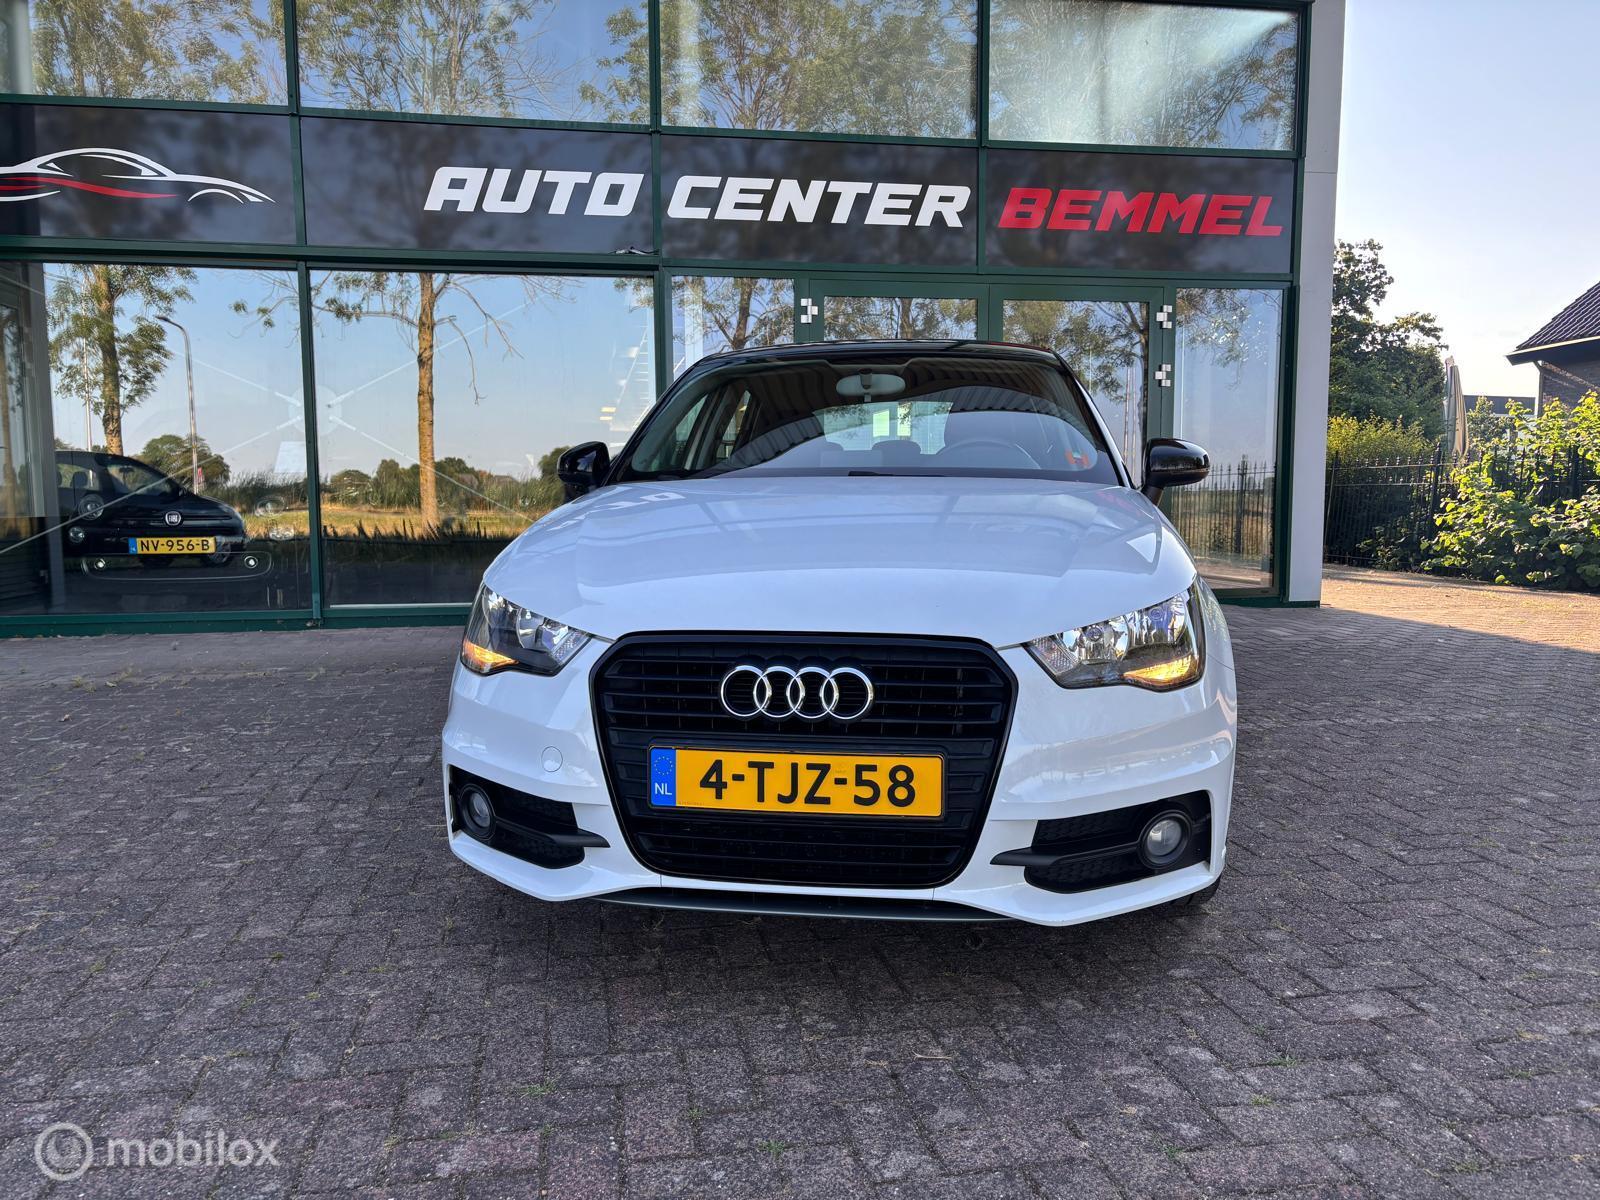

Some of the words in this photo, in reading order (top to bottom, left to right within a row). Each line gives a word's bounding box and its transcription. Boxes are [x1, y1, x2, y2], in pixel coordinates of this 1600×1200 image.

[423, 166, 645, 217] AUTO
[667, 175, 971, 228] CENTER
[998, 187, 1283, 236] BEMMEL
[140, 539, 210, 552] NV-956-B
[654, 782, 672, 796] NL
[699, 758, 917, 808] 4-TJZ-58
